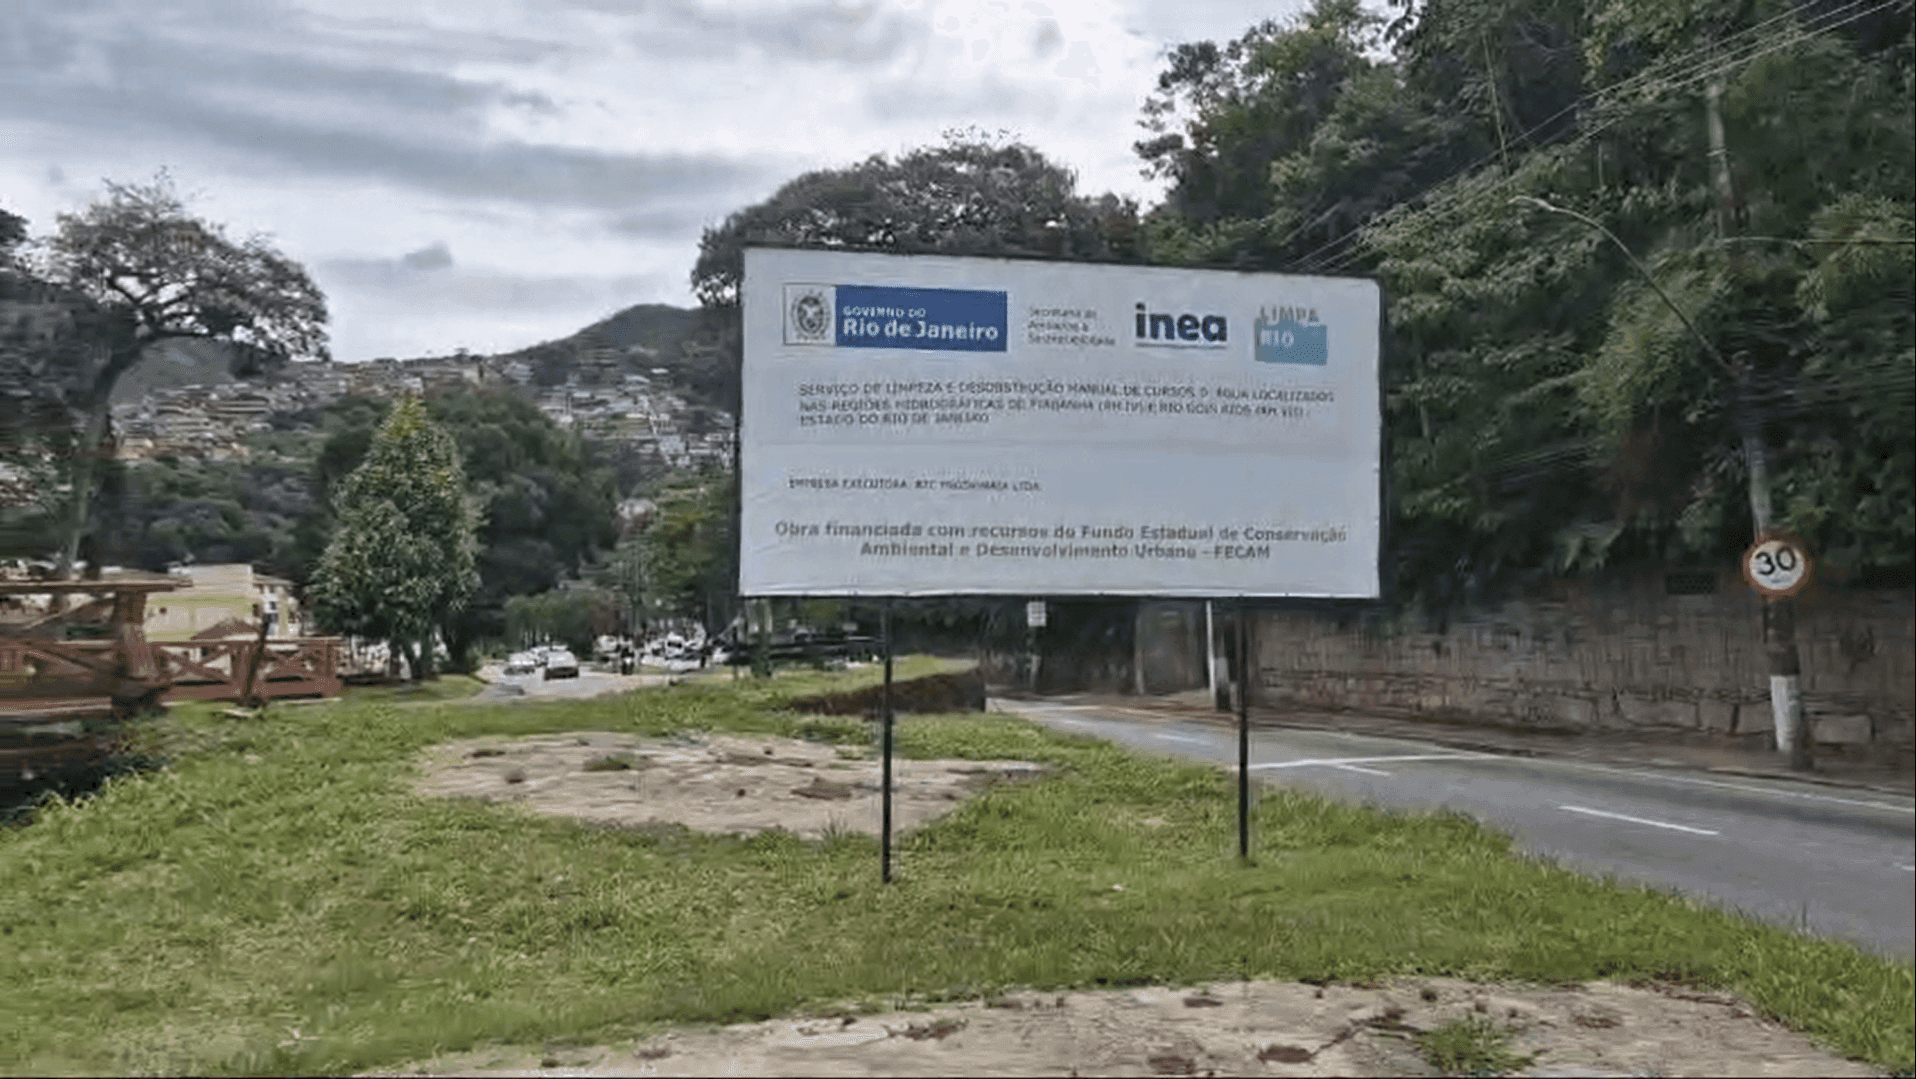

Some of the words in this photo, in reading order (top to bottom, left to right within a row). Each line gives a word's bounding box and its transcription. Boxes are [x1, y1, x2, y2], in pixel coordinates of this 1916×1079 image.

[908, 307, 926, 318] DO
[1135, 302, 1228, 342] inea
[1259, 305, 1320, 324] LIMPA
[843, 318, 880, 337] Rio
[884, 319, 912, 338] de
[915, 320, 999, 341] Janeiro
[1260, 329, 1295, 347] RIO
[800, 382, 859, 396] SERVIÇO
[863, 383, 881, 394] DE
[886, 382, 943, 395] LIMPEZA
[946, 382, 953, 394] E
[959, 379, 1065, 395] DESOBSTRUÇÃO
[1068, 382, 1118, 396] MANUAL
[1123, 384, 1141, 397] DE
[1144, 385, 1196, 398] CURSOS
[1252, 388, 1335, 403] LOCALIZADOS
[1159, 402, 1183, 414] RIO
[800, 413, 855, 426] ESTADO
[859, 412, 879, 425] DO
[882, 412, 908, 425] RIO
[911, 412, 928, 425] DE
[775, 520, 820, 537] Obra
[825, 520, 922, 537] financiada
[928, 525, 965, 538] com
[971, 525, 1048, 539] recursos
[1053, 524, 1076, 539] do
[1081, 524, 1134, 540] Fundo
[1141, 525, 1213, 541] Estadual
[1219, 526, 1239, 541] de
[1243, 527, 1347, 545] Conservação
[860, 541, 954, 557] Ambiental
[960, 544, 971, 557] e
[976, 542, 1129, 560] Desenvolvimento
[1135, 543, 1197, 560] Urbano
[1214, 545, 1270, 561] FECAM
[1755, 546, 1796, 576] 30
